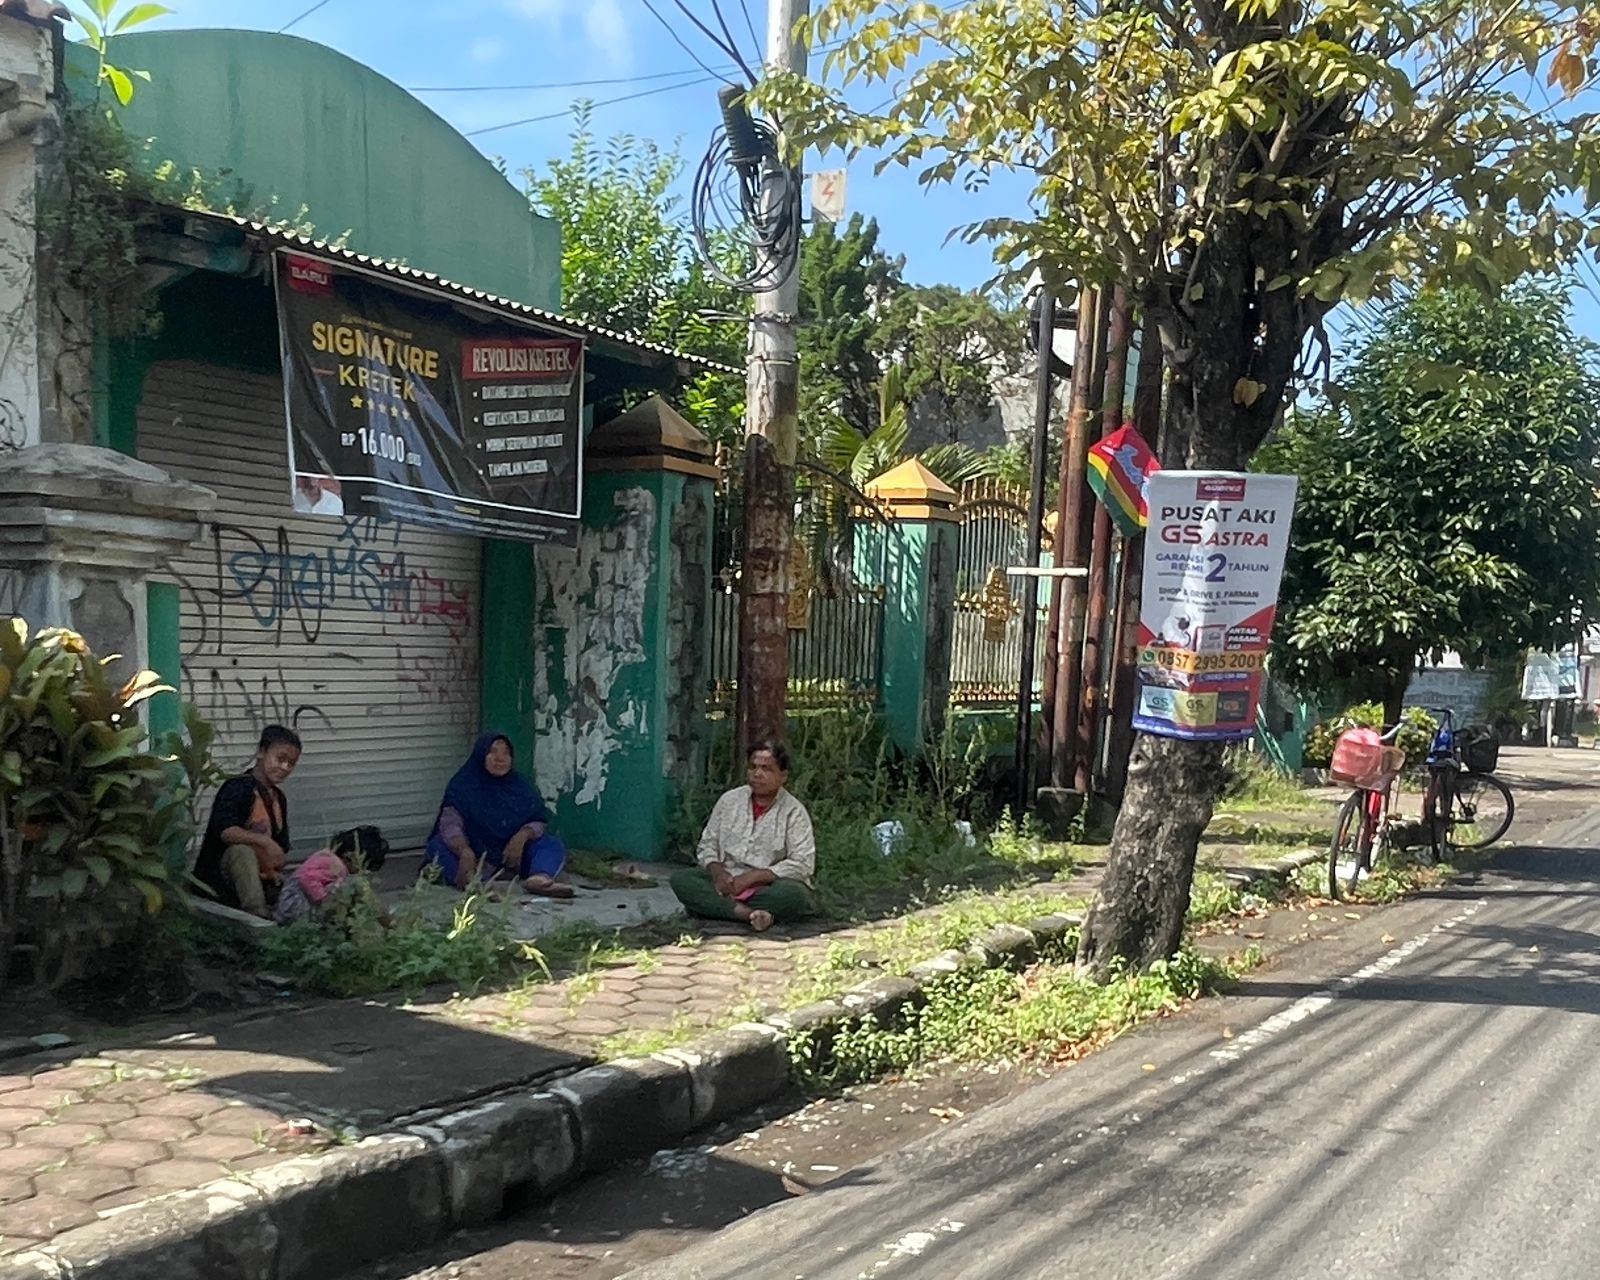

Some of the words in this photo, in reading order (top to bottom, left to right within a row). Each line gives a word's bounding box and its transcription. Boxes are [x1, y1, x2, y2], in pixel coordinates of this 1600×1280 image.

[312, 321, 439, 378] SIGNATURE
[472, 348, 528, 372] REVOLUSI
[529, 348, 573, 371] KRETEK
[339, 364, 416, 402] KRETEK
[358, 427, 404, 462] 16.000
[1161, 507, 1232, 522] PUSAT
[1237, 508, 1276, 523] AKI
[1161, 525, 1203, 544] GS
[1205, 532, 1268, 546] ASTRA
[1156, 553, 1204, 563] GARANSI
[1205, 553, 1227, 582] 2
[1228, 563, 1269, 572] TAHUN
